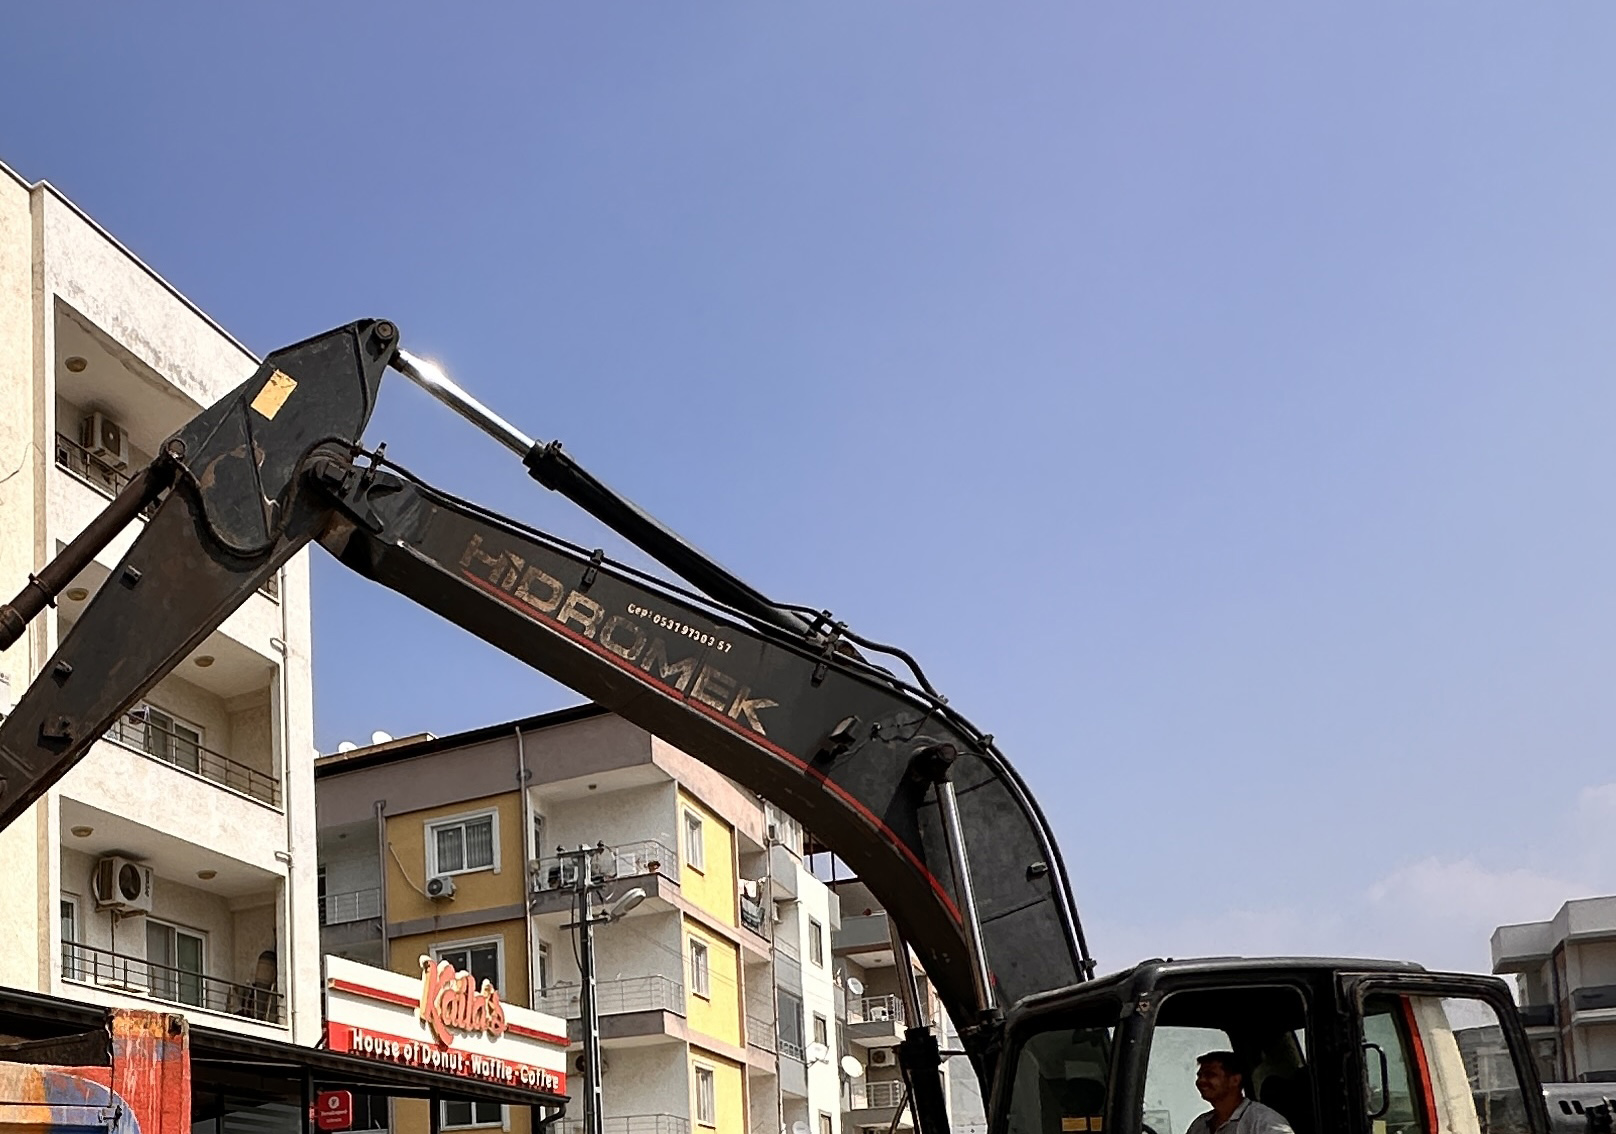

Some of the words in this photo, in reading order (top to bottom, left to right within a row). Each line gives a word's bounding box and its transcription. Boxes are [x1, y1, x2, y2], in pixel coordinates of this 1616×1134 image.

[352, 1028, 400, 1057] House
[403, 1040, 421, 1062] of
[421, 1046, 464, 1072] Donut
[471, 1054, 512, 1081] Waffle
[519, 1064, 559, 1090] Coffee
